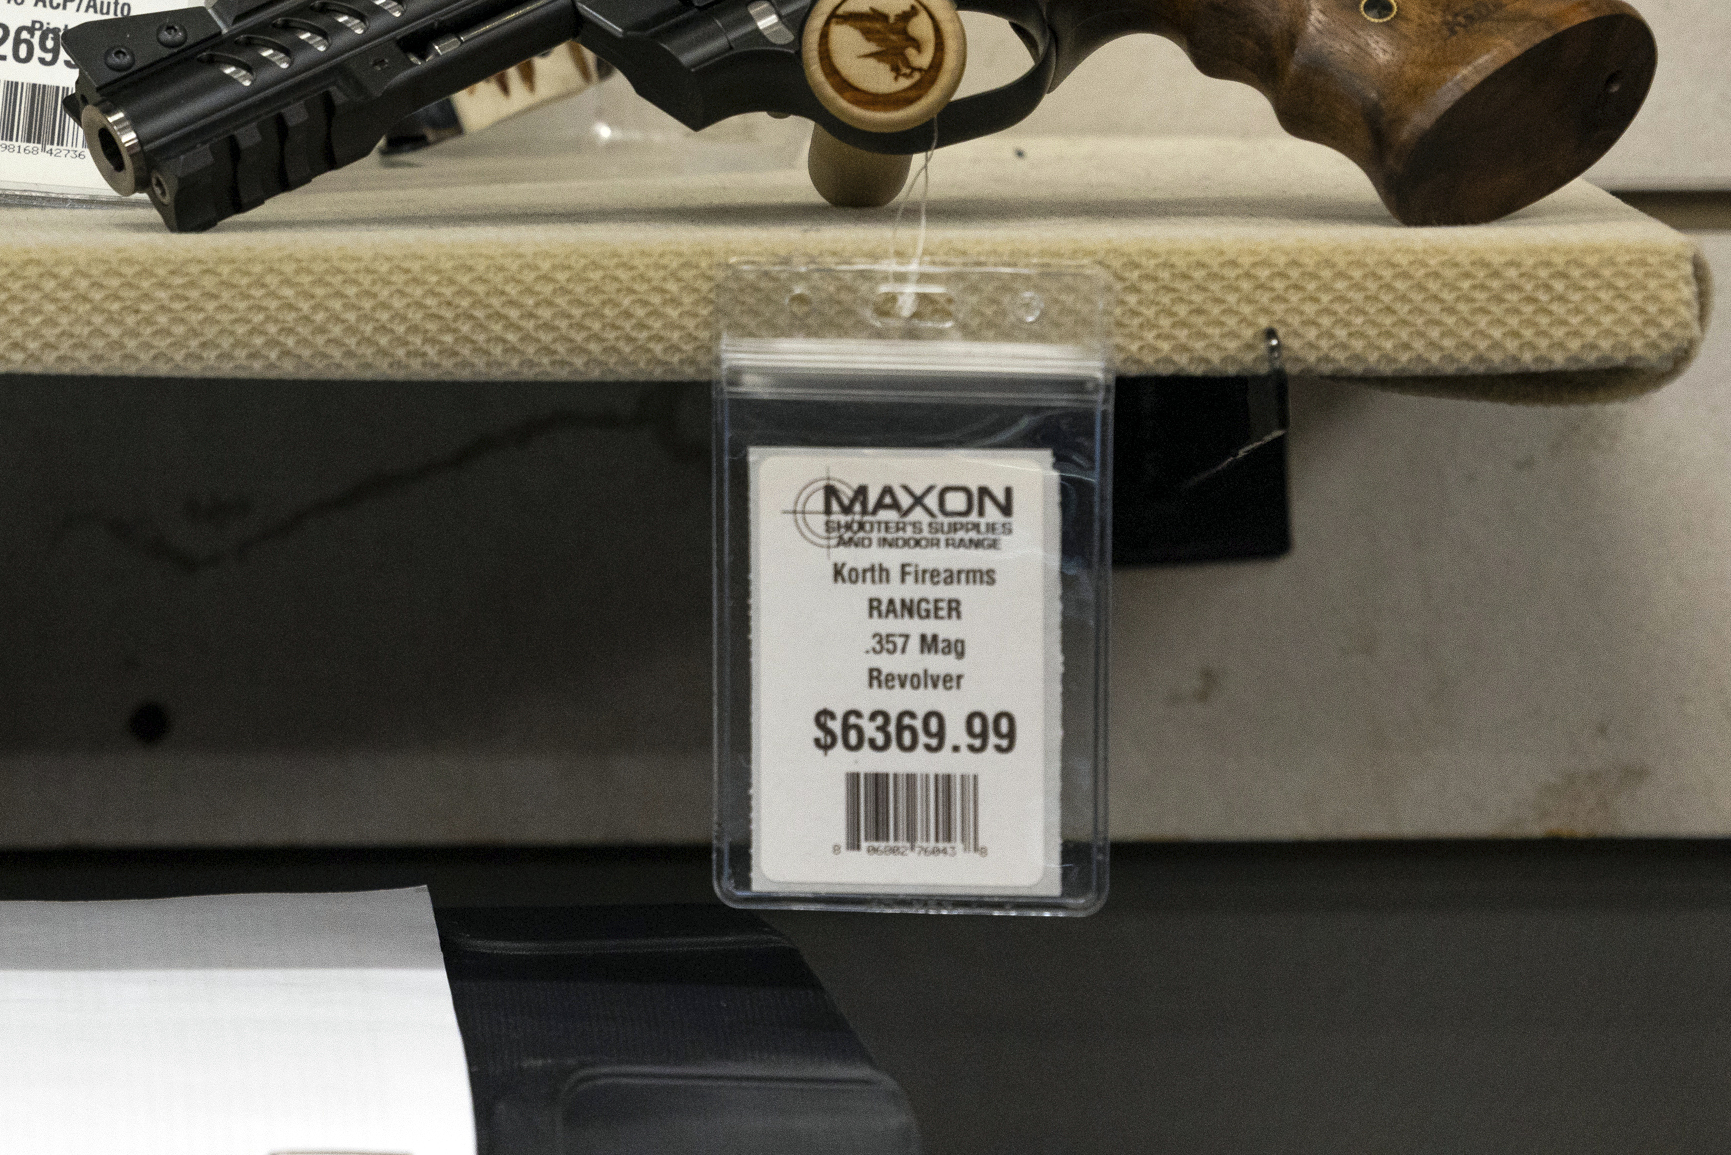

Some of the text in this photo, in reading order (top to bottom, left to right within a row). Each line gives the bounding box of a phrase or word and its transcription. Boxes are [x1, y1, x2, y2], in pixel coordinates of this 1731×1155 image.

[0, 143, 40, 156] 98168
[46, 148, 86, 160] 42736
[823, 483, 1013, 518] MAXON
[825, 520, 1013, 536] SHOOTER'S SUPPLIES
[836, 535, 1001, 551] AND INDOOR RANGE
[833, 562, 997, 586] Korth Firearms
[868, 597, 962, 620] RANGER
[865, 632, 966, 660] .357 Mag
[868, 667, 964, 690] Revolver
[813, 707, 1017, 757] $6369.99
